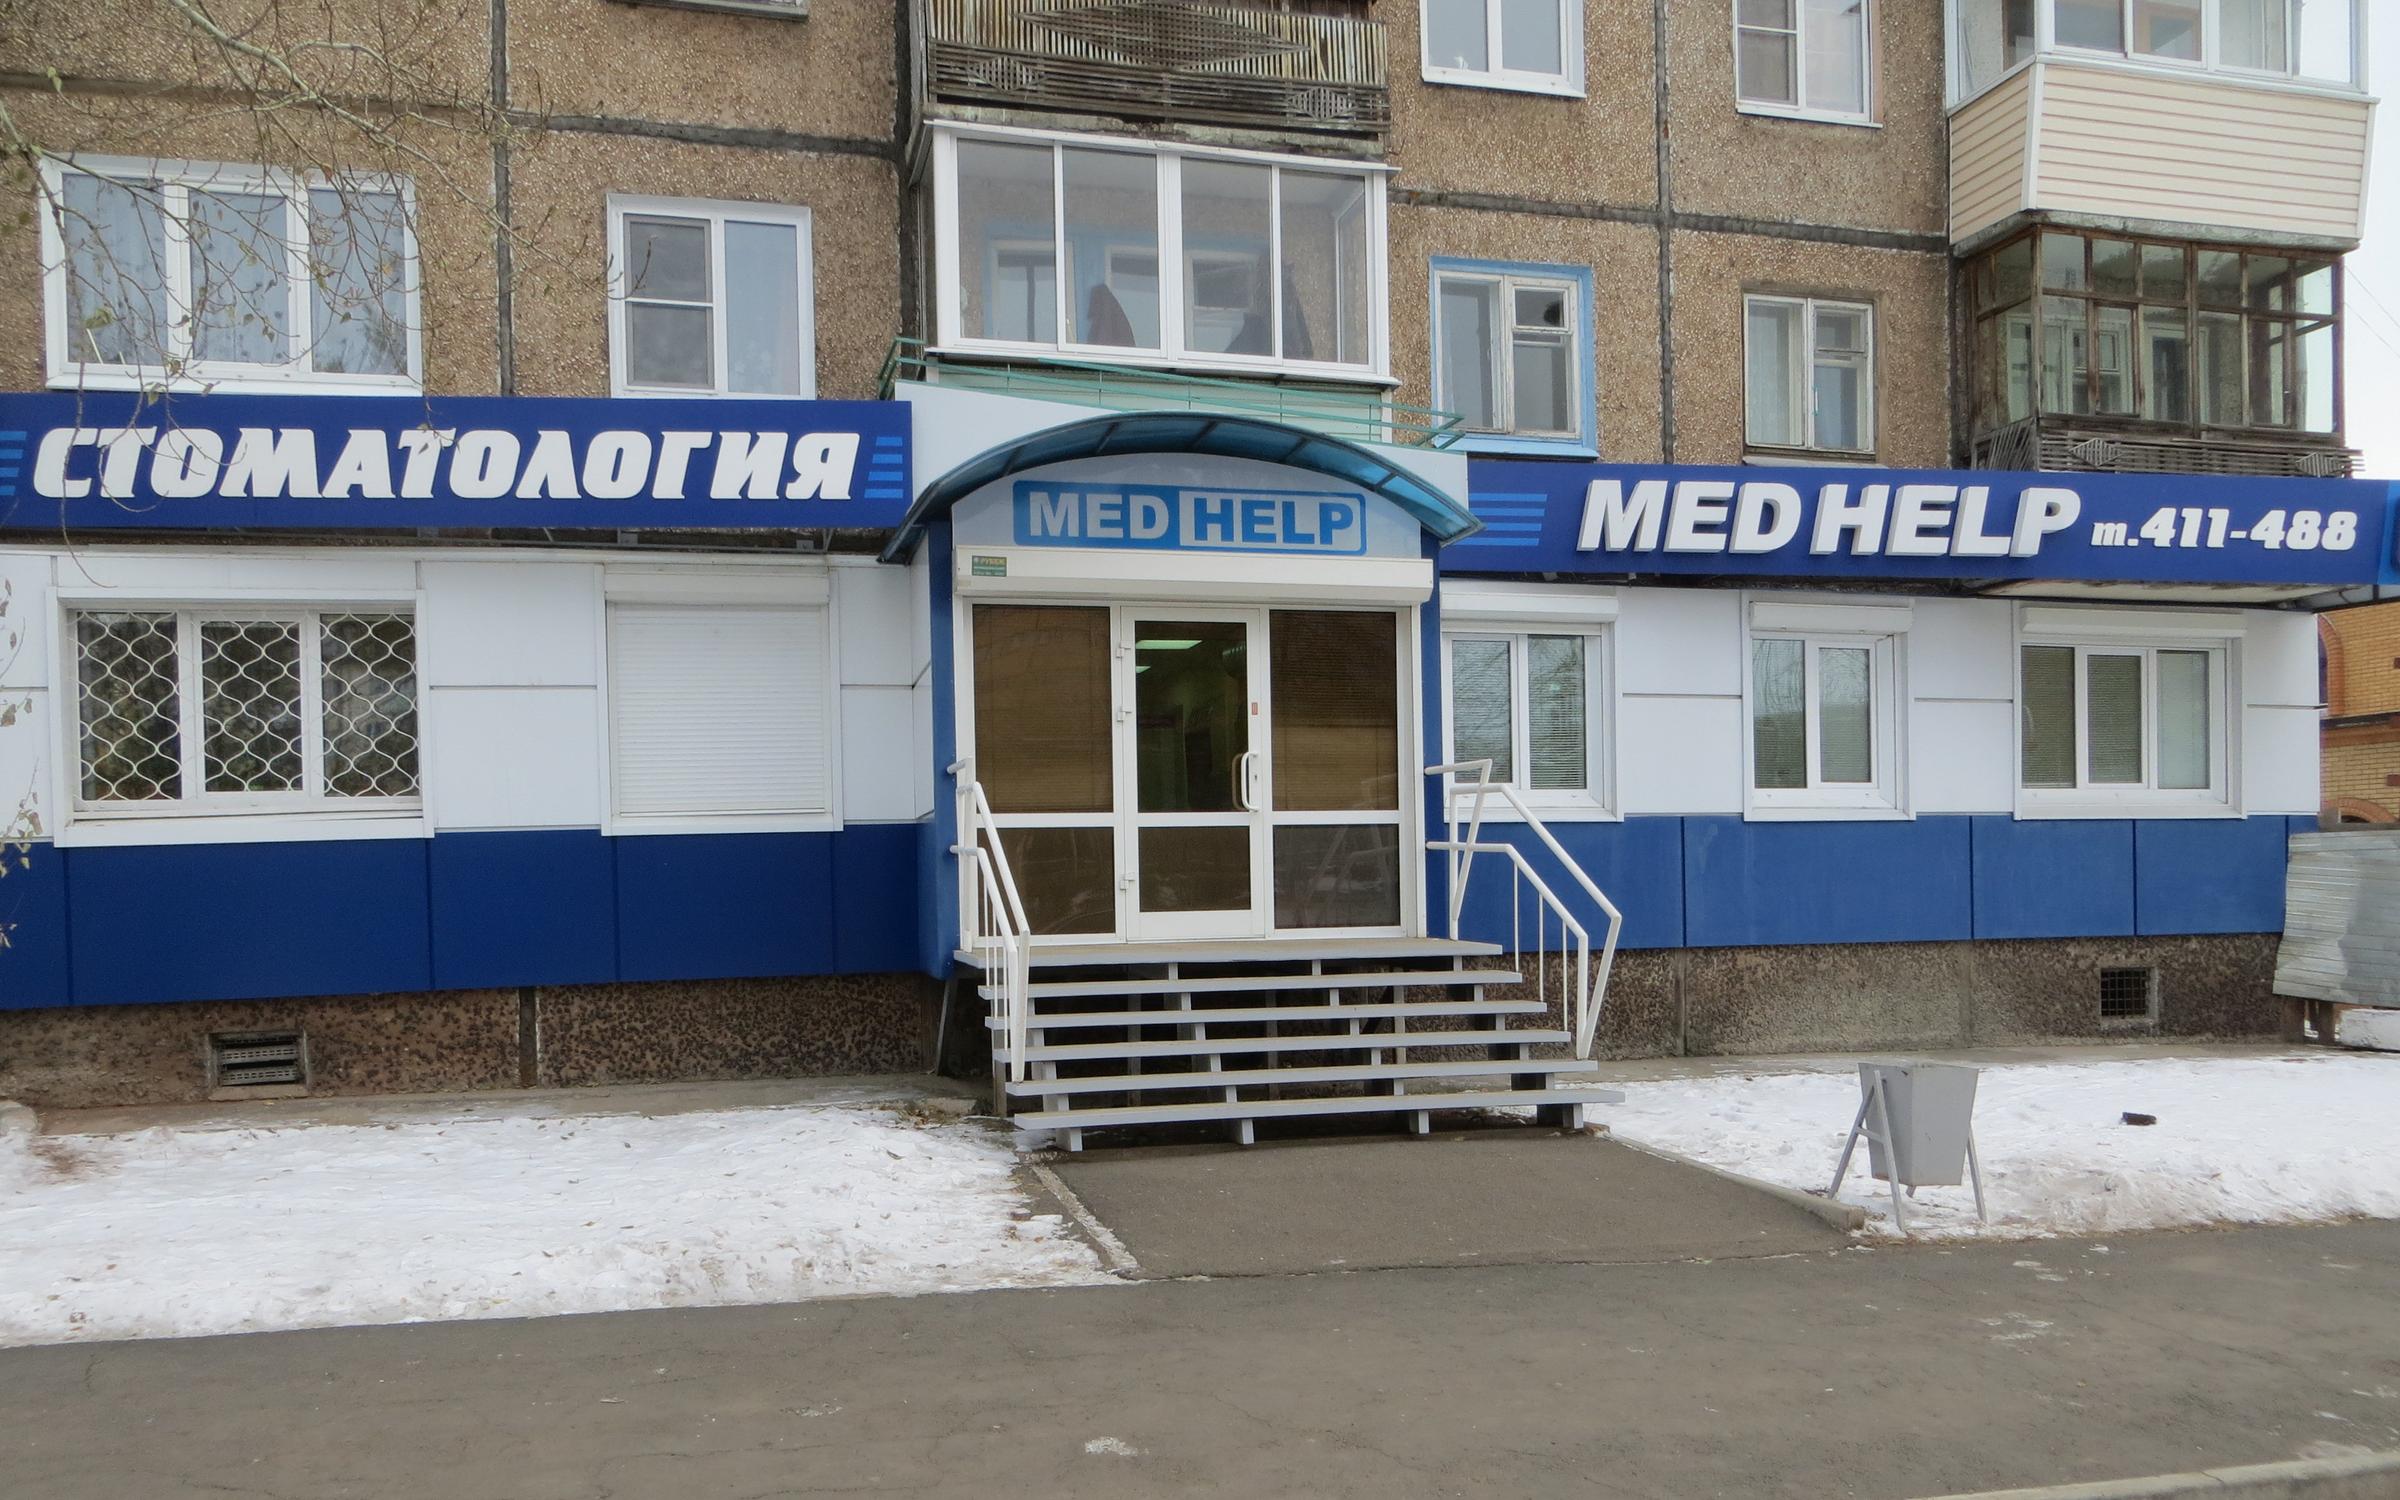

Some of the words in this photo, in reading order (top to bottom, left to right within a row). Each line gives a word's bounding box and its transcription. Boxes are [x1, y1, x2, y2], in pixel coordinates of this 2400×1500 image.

[33, 427, 860, 500] СТОМАТОЛОГИЯ
[1028, 491, 1169, 540] MED
[1193, 497, 1354, 546] HELP
[1577, 479, 1802, 551] MED
[1810, 484, 2081, 557] HELP
